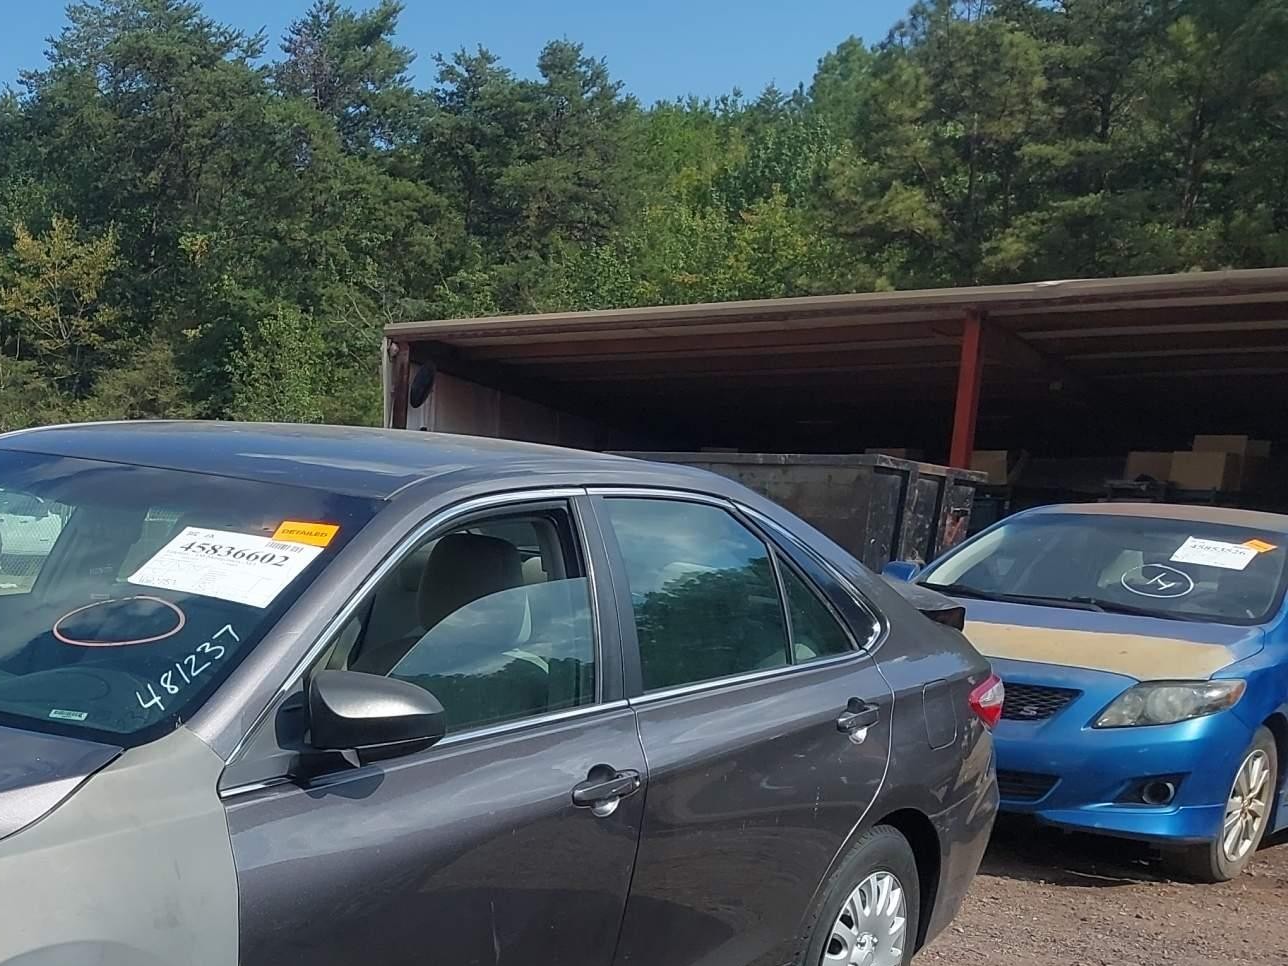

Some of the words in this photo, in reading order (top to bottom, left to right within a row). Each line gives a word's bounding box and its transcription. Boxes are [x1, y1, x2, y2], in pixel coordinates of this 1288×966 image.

[281, 528, 328, 538] DETAILED
[180, 541, 290, 567] 45836602
[136, 624, 241, 711] 481237
